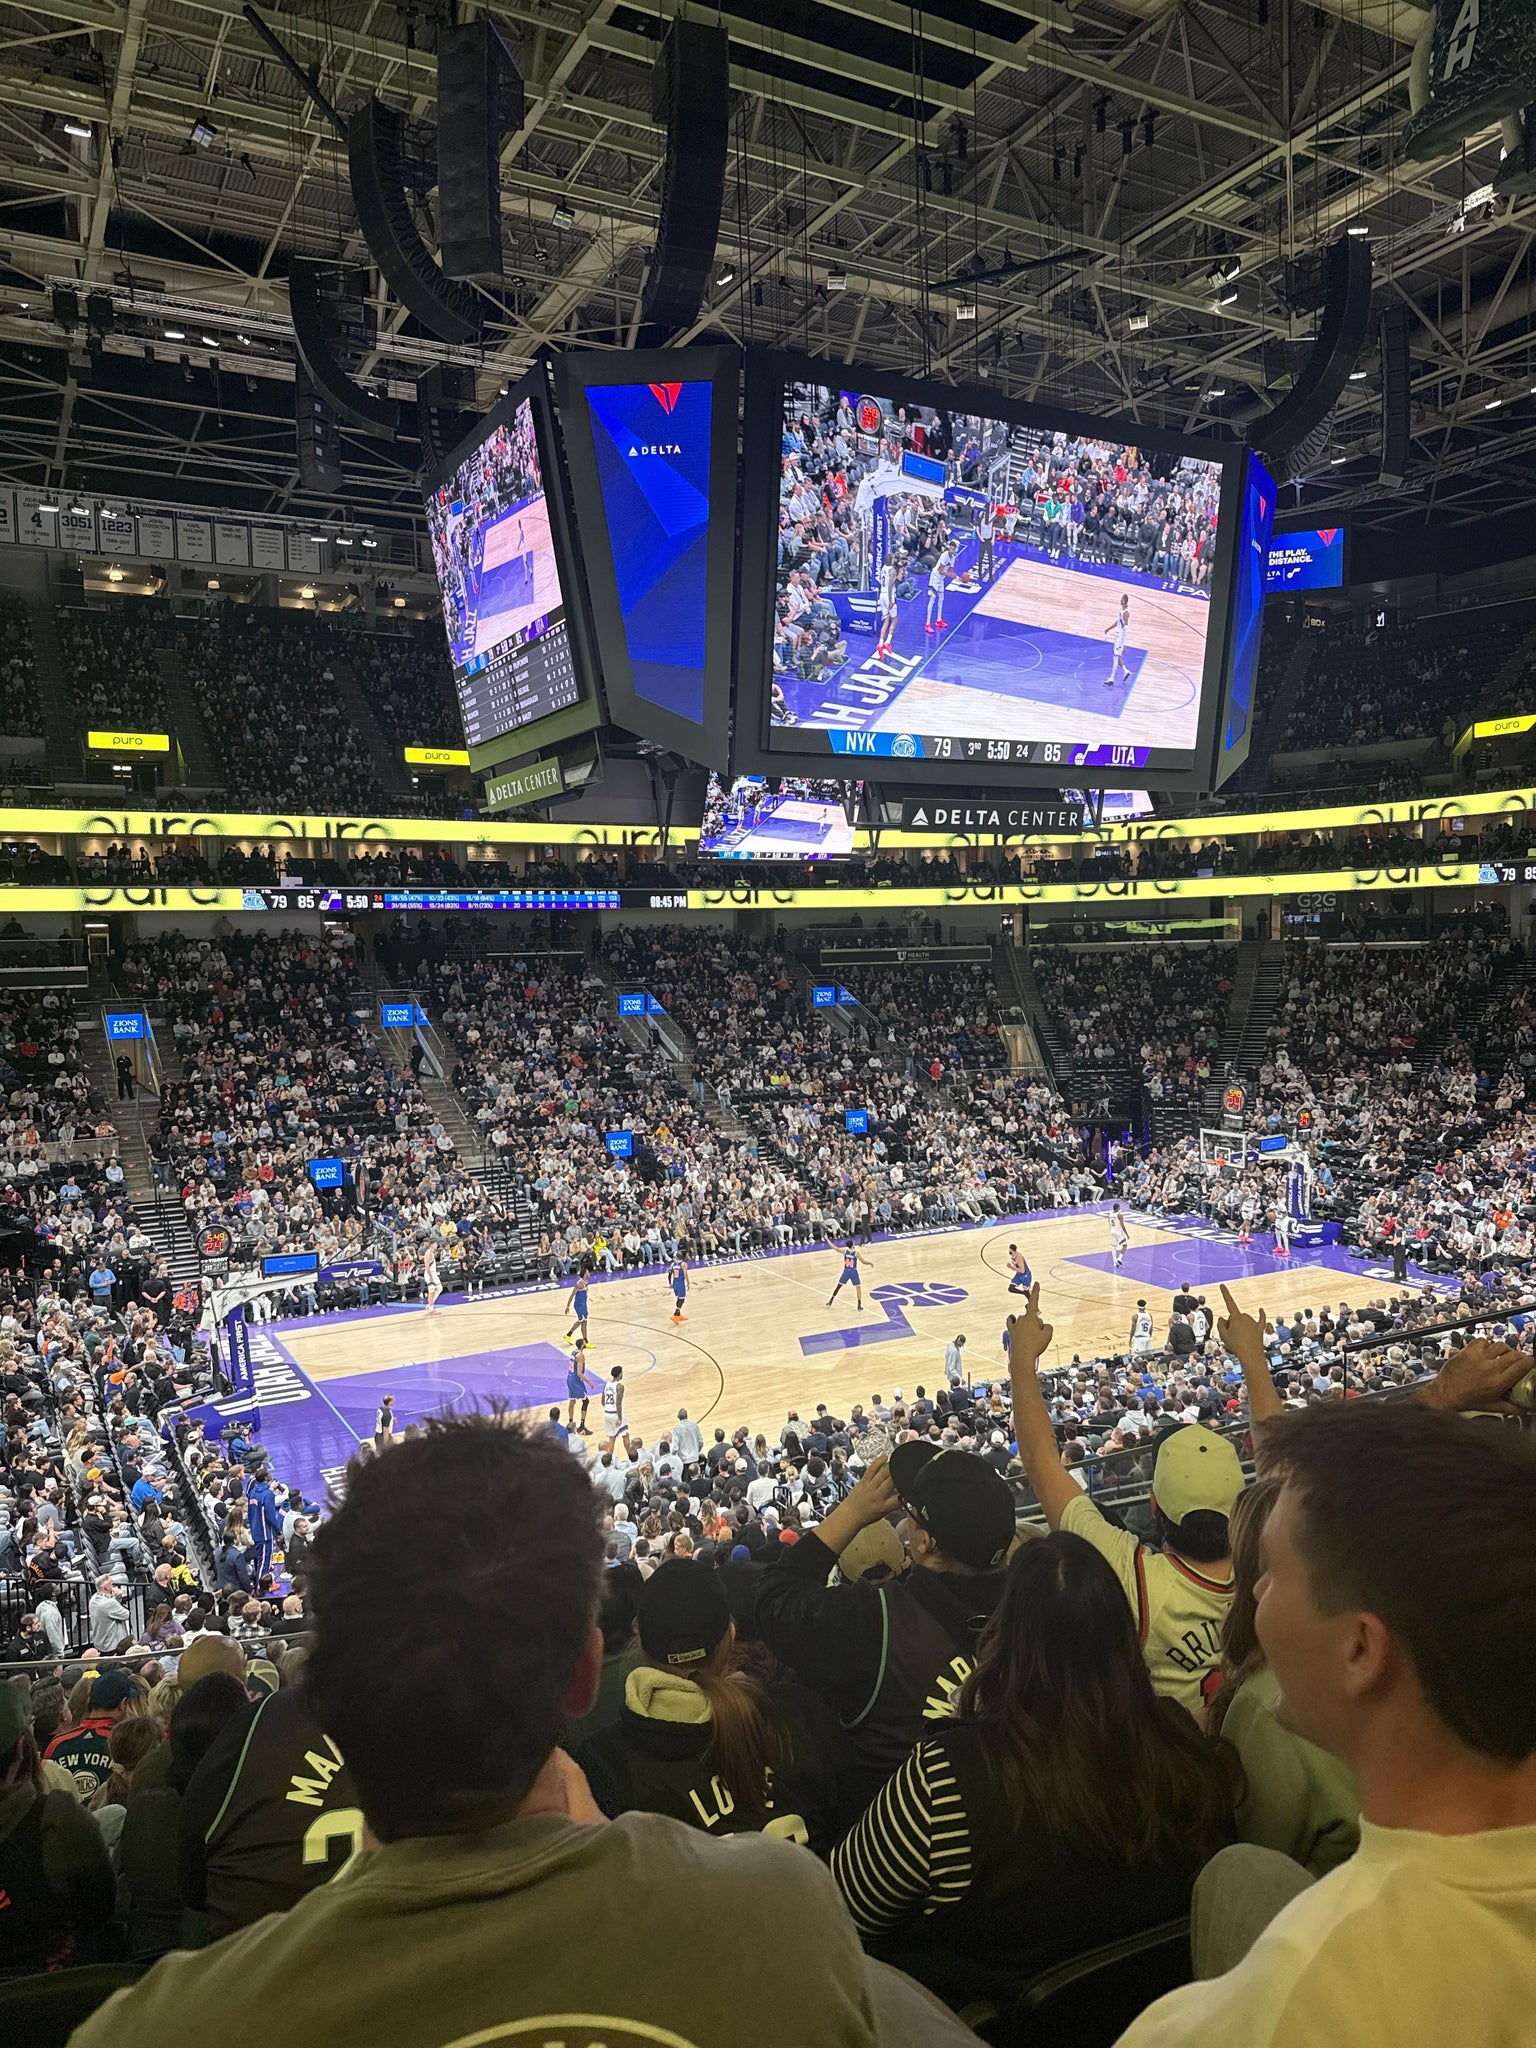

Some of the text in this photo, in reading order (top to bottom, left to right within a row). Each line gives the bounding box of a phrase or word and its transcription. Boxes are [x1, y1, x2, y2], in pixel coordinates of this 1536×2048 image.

[641, 445, 681, 456] DELTA
[31, 513, 42, 528] 4
[61, 515, 92, 529] 3051
[102, 519, 133, 534] 1223
[1286, 548, 1307, 557] PLAY.
[875, 540, 883, 582] AMERICA
[1269, 555, 1313, 566] DISTANCE.
[1495, 720, 1519, 732] pura
[112, 735, 143, 747] pura
[846, 732, 875, 752] NYK
[934, 739, 952, 757] 79
[987, 741, 1010, 760] 5:50
[1016, 744, 1029, 758] 24
[1044, 744, 1061, 762] 85
[1111, 746, 1135, 764] UTA
[424, 751, 450, 762] pura
[497, 768, 558, 802] DELTA CENTER
[934, 809, 1078, 827] DELTA CENTER
[1502, 868, 1516, 880] 79
[271, 895, 368, 909] 79 85 5:50
[374, 894, 383, 902] 24
[650, 895, 687, 908] 08:45 PM
[1297, 892, 1336, 907] G2G
[113, 1026, 139, 1034] BANK
[1226, 1096, 1242, 1111] 24
[315, 1166, 337, 1174] ZIONS
[207, 1233, 225, 1242] 5:49
[1169, 1226, 1253, 1244] JAZZ
[205, 1241, 222, 1253] 24
[1141, 1322, 1150, 1332] 16
[234, 1319, 249, 1381] AMERICA FIRST
[253, 1364, 311, 1407] UTAH
[606, 1393, 615, 1405] 28
[1165, 1619, 1221, 1673] BRU
[54, 1754, 80, 1768] EW
[286, 1734, 345, 1807] MA
